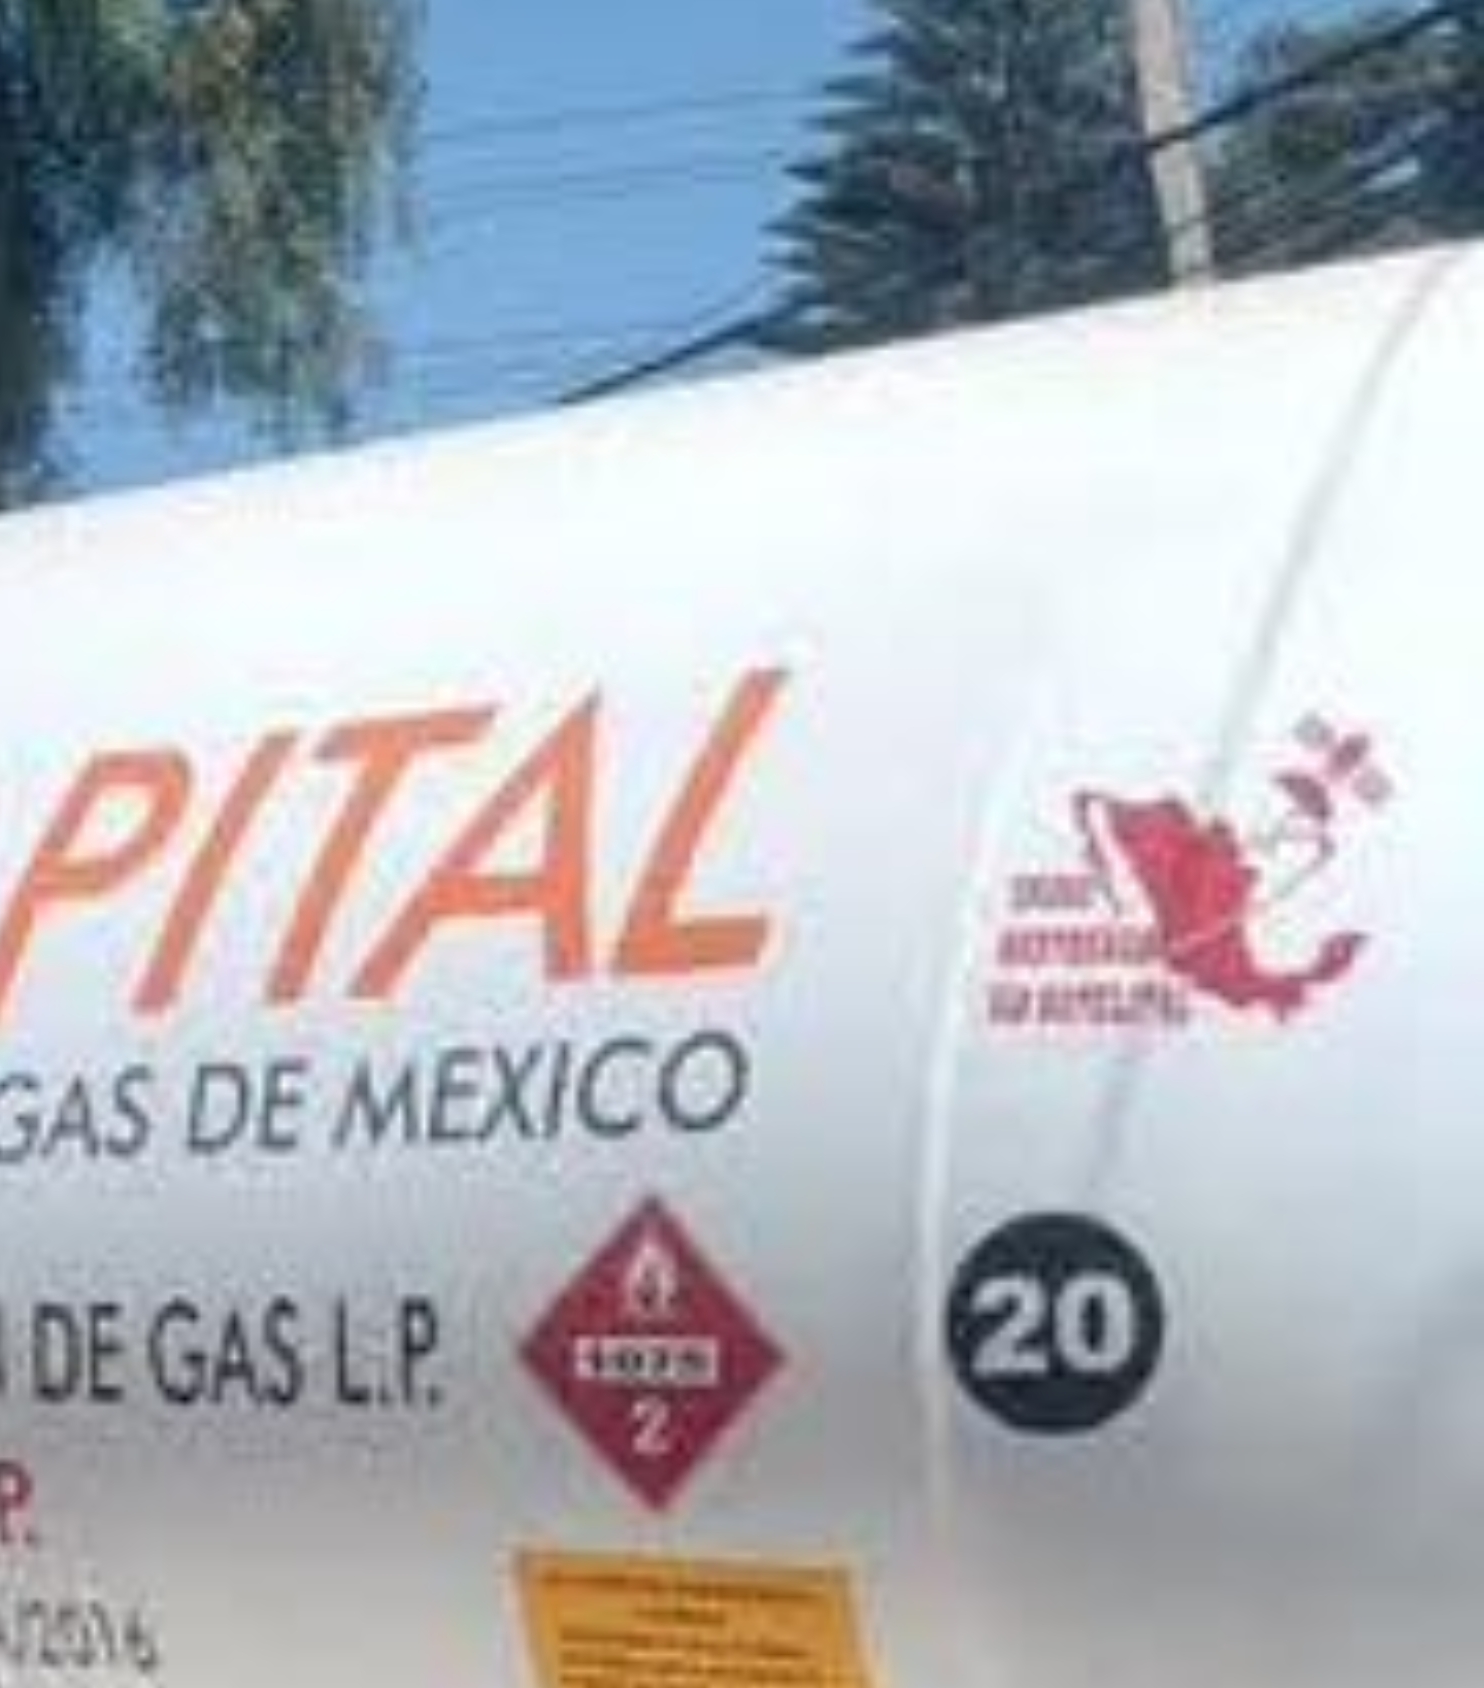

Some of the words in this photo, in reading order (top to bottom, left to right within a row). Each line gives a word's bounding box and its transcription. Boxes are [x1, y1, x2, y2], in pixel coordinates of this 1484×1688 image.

[186, 1058, 306, 1154] DE
[331, 1030, 748, 1148] MEXICO
[32, 1302, 124, 1403] DE
[146, 1298, 304, 1406] GAS
[335, 1301, 445, 1407] L.P.
[970, 1273, 1136, 1380] 20
[632, 1401, 671, 1454] 2
